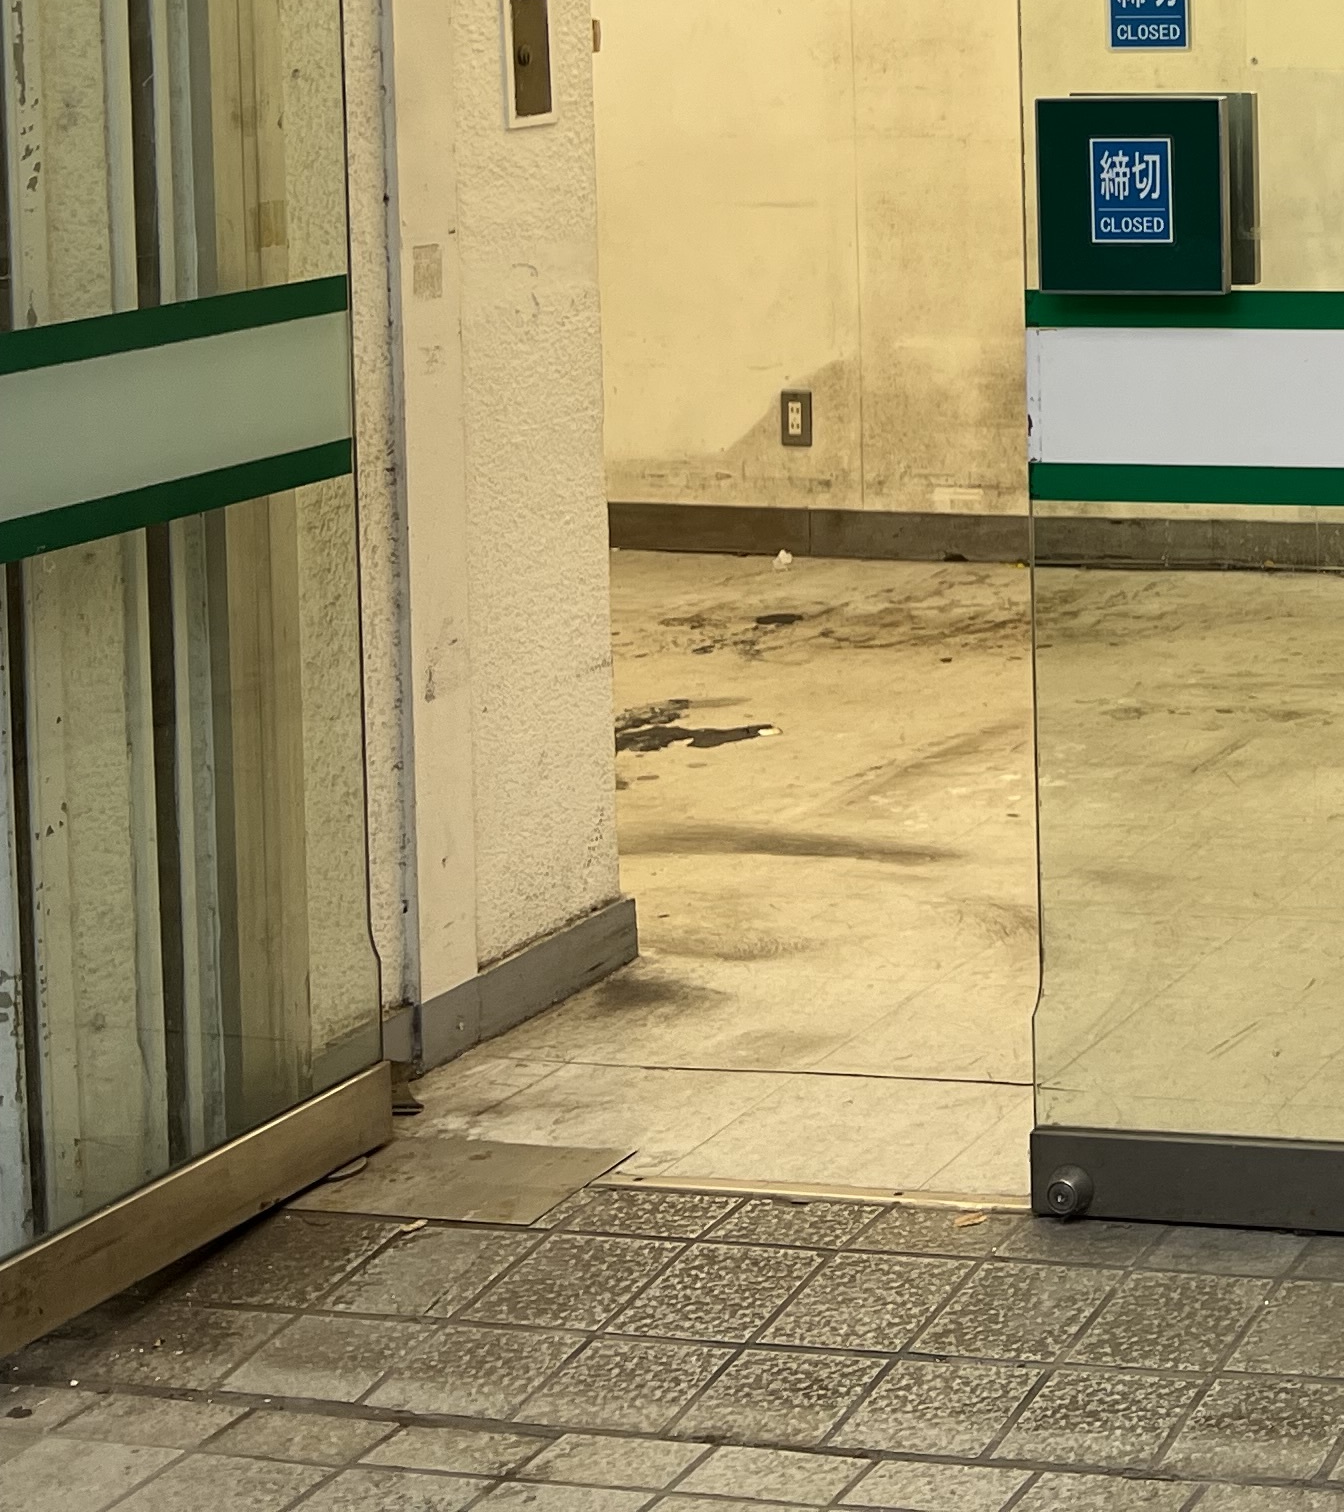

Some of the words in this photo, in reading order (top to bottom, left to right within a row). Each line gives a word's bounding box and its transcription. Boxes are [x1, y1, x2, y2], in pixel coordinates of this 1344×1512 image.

[1116, 23, 1181, 41] CLOSED
[1100, 149, 1161, 201] 締切
[1100, 216, 1164, 234] CLOSED
